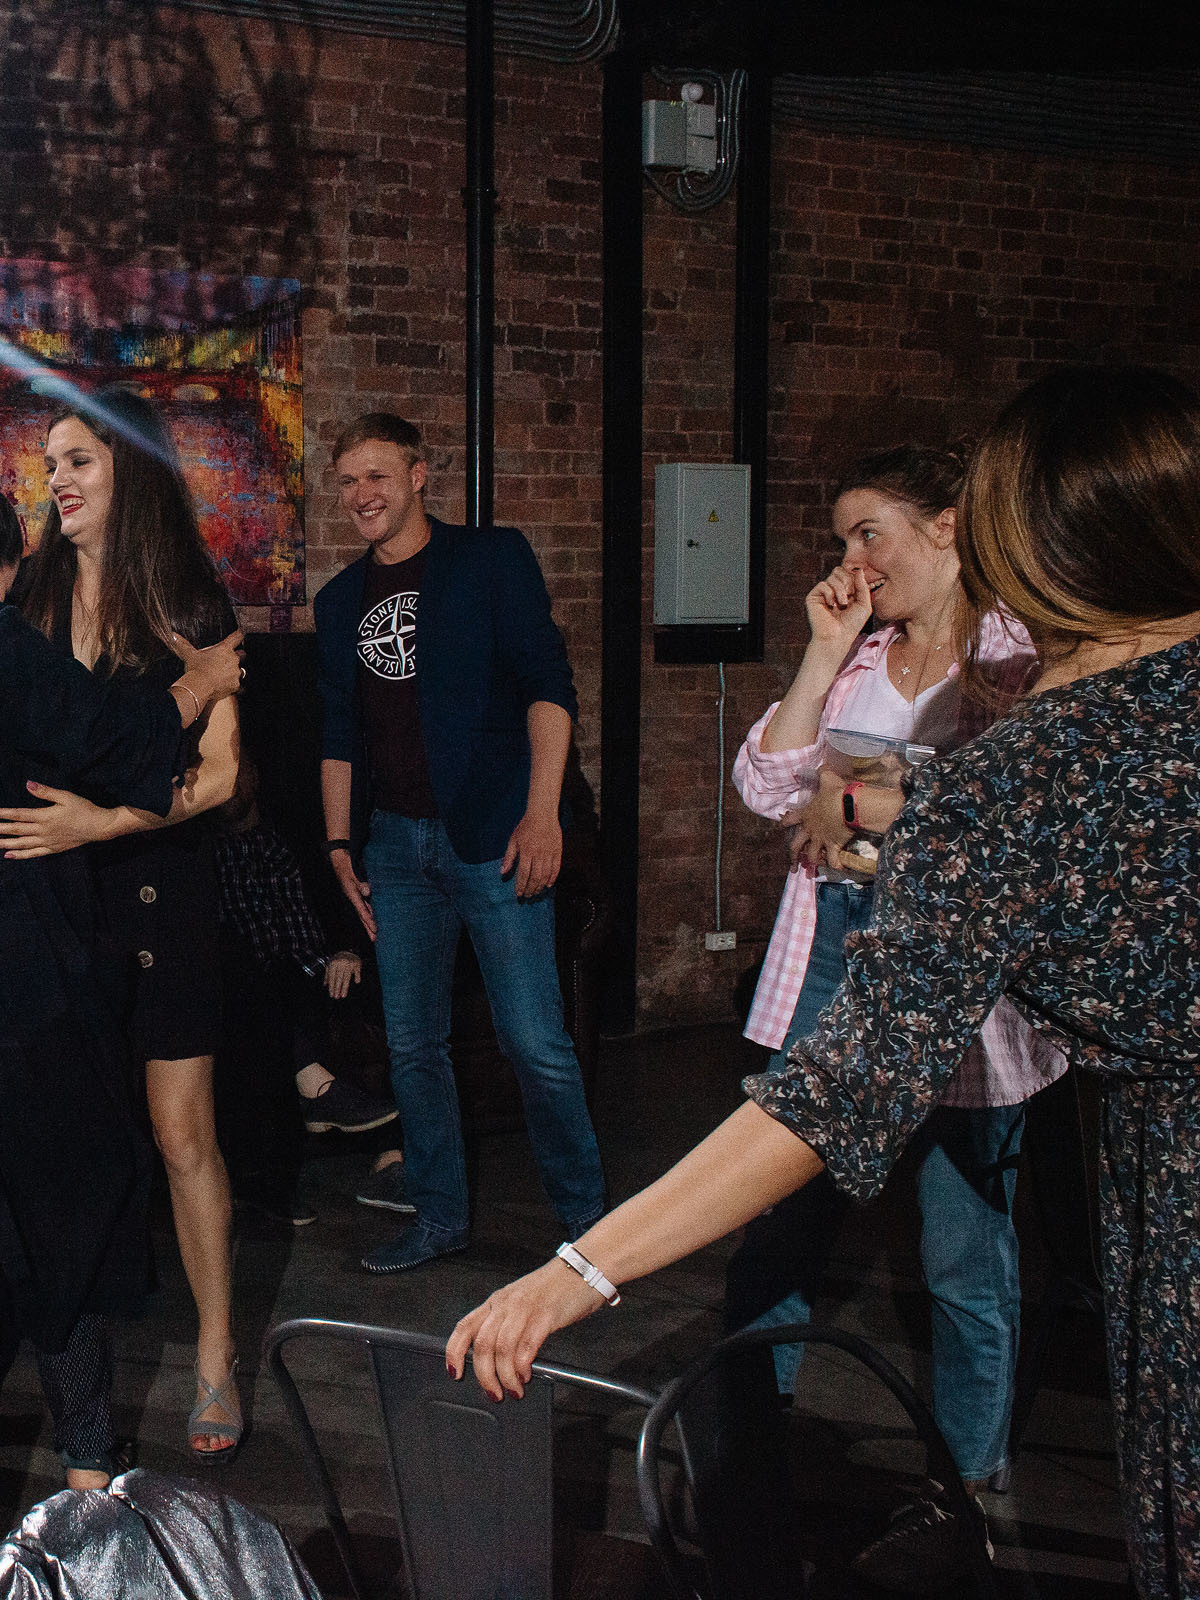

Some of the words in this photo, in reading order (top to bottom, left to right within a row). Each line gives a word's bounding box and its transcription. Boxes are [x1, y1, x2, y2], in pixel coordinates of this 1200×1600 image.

[361, 600, 395, 637] STONE
[401, 596, 418, 611] ISL
[362, 644, 400, 674] ISLAND
